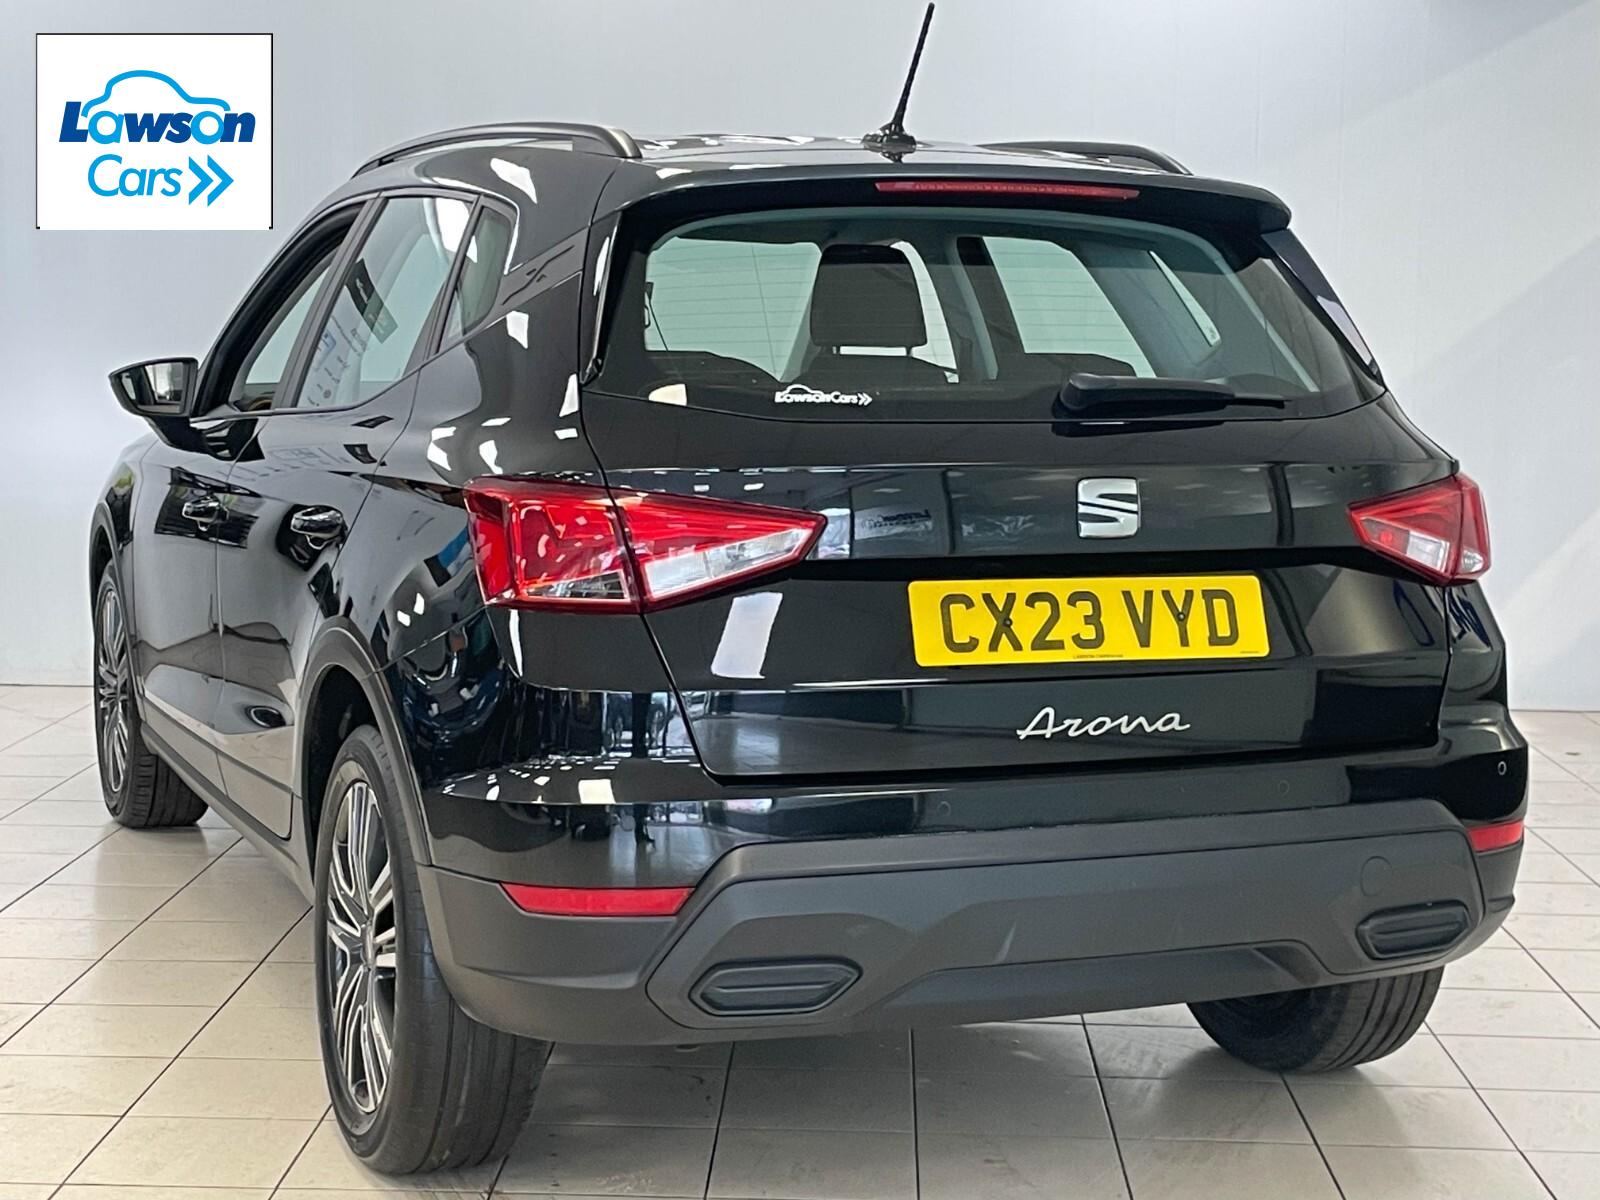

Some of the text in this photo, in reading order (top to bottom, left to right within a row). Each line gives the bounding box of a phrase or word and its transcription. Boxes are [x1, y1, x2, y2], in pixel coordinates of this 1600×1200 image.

[939, 589, 1241, 653] CX23 VYD
[1016, 706, 1191, 740] Arona
